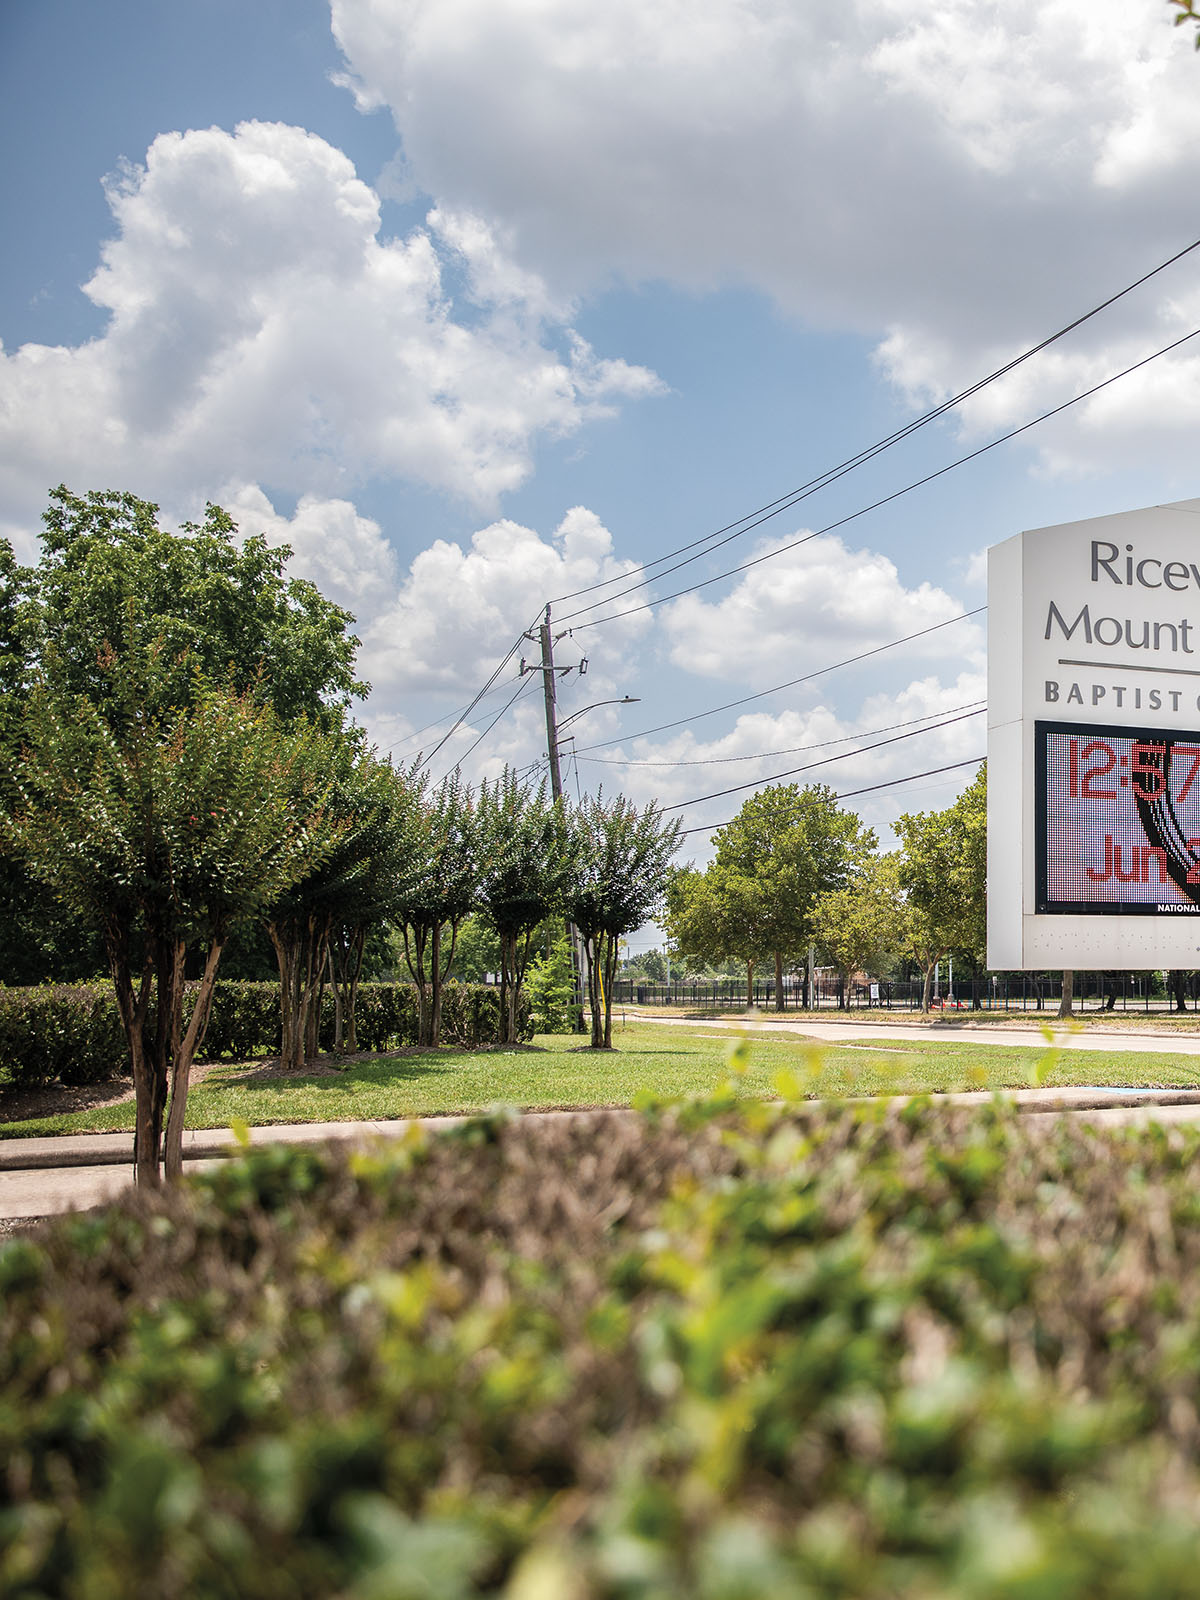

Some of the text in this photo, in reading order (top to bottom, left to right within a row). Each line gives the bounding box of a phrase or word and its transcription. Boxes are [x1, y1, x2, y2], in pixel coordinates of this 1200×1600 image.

[1044, 601, 1194, 653] Mount
[1044, 680, 1182, 712] BAPTIST
[1086, 834, 1168, 883] Jun
[1157, 904, 1200, 912] NATIONAL
